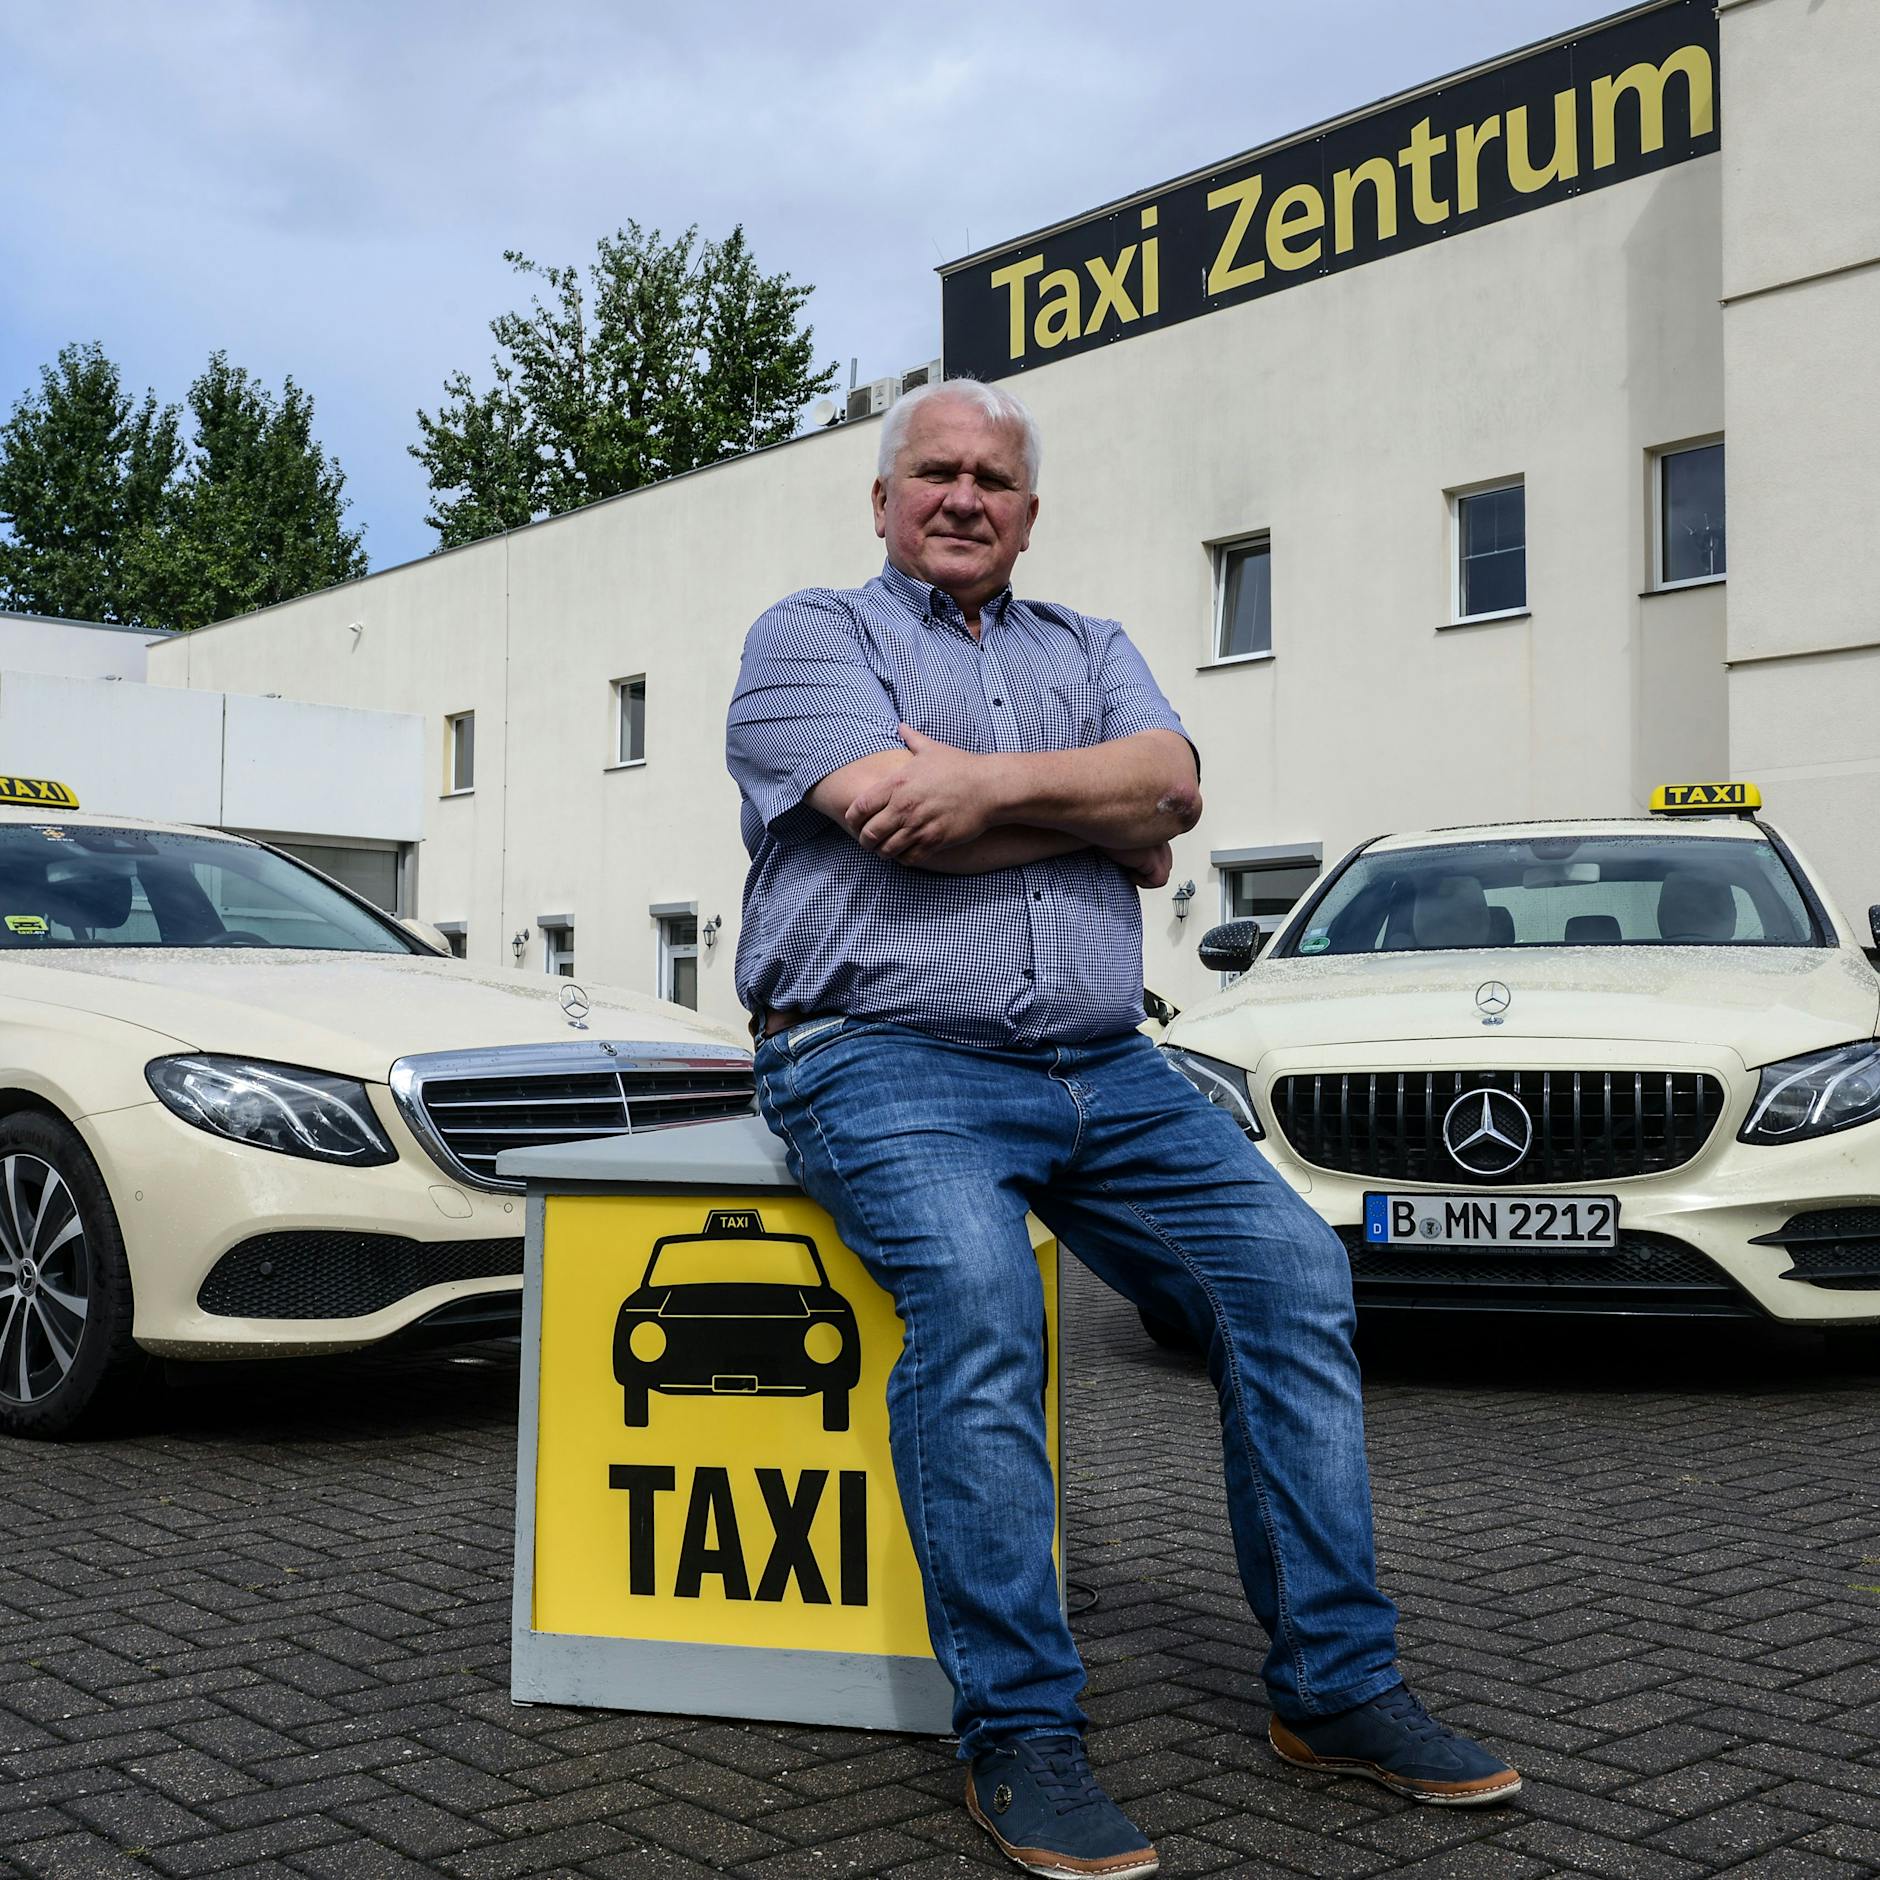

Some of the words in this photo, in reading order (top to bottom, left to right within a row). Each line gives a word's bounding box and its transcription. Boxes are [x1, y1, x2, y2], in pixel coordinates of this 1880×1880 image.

[991, 205, 1159, 360] Taxi
[1207, 44, 1714, 296] Zentrum
[1668, 785, 1741, 804] TAXI
[719, 1216, 748, 1229] TAXI
[1373, 1223, 1382, 1235] D
[1392, 1200, 1416, 1237] B
[1445, 1201, 1497, 1239] MN
[1509, 1203, 1611, 1241] 2212
[609, 1464, 869, 1607] TAXI
